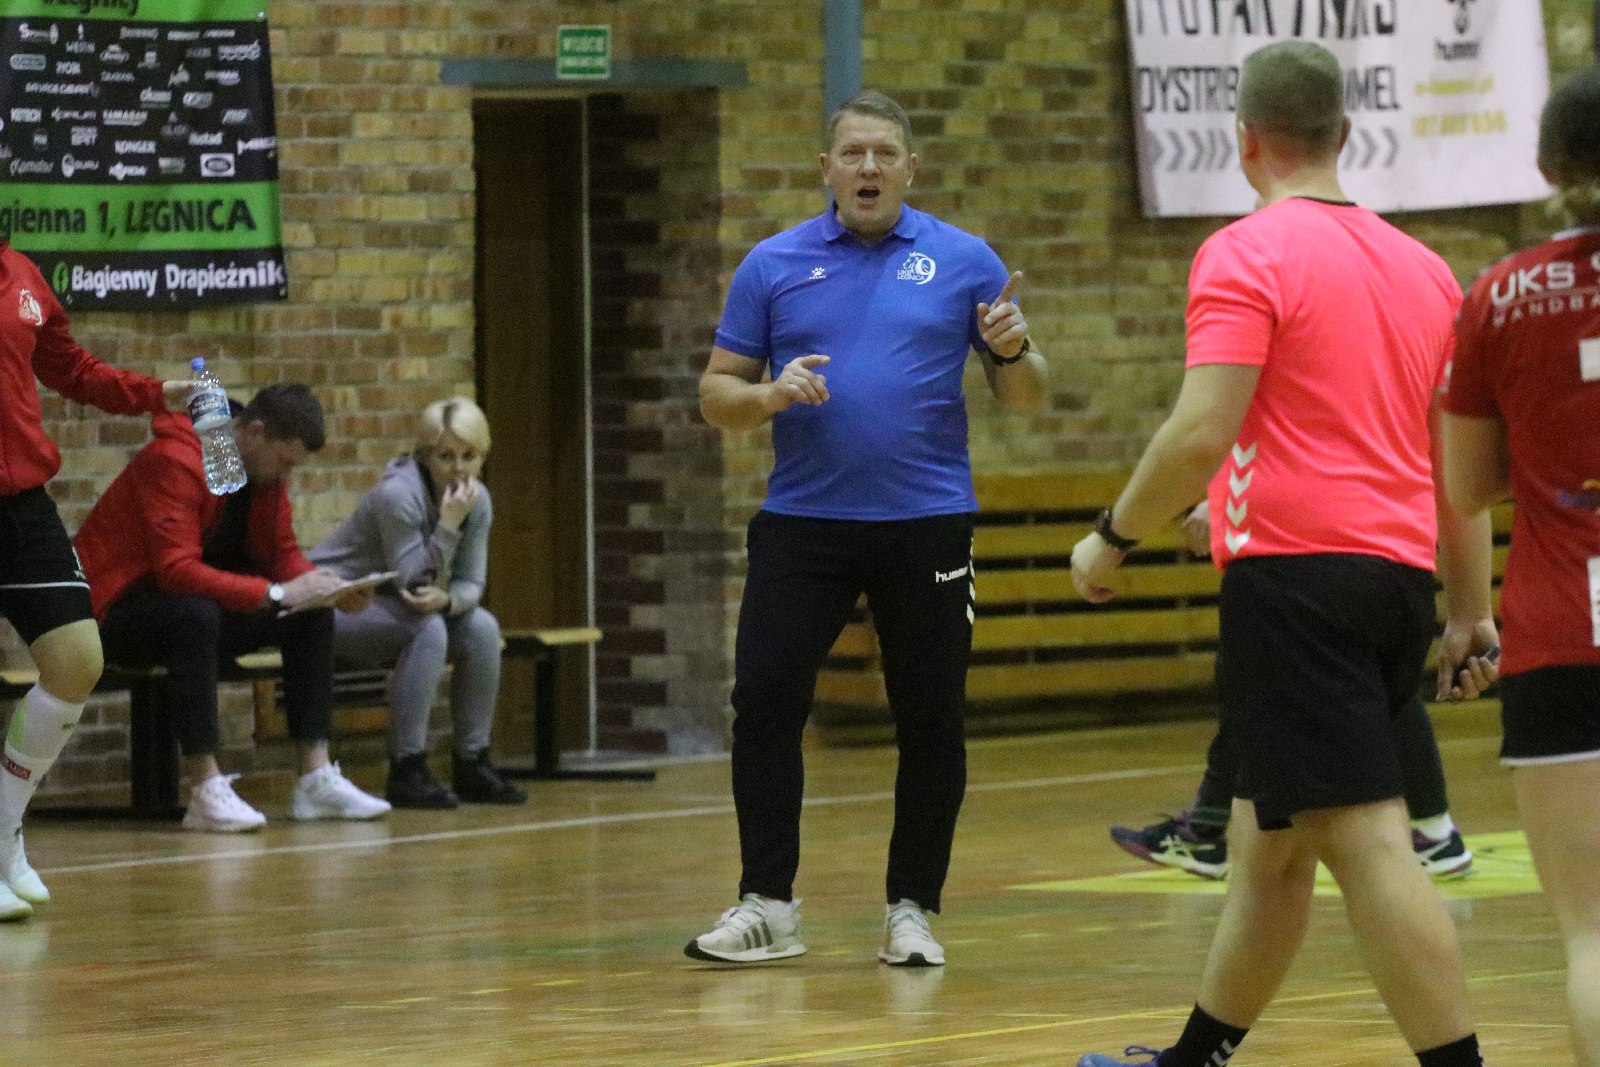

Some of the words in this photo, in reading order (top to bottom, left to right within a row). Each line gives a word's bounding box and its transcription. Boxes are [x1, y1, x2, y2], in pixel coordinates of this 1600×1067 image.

[124, 199, 256, 233] LEGNICA
[71, 265, 158, 298] Bagienny
[1490, 260, 1576, 306] UKS
